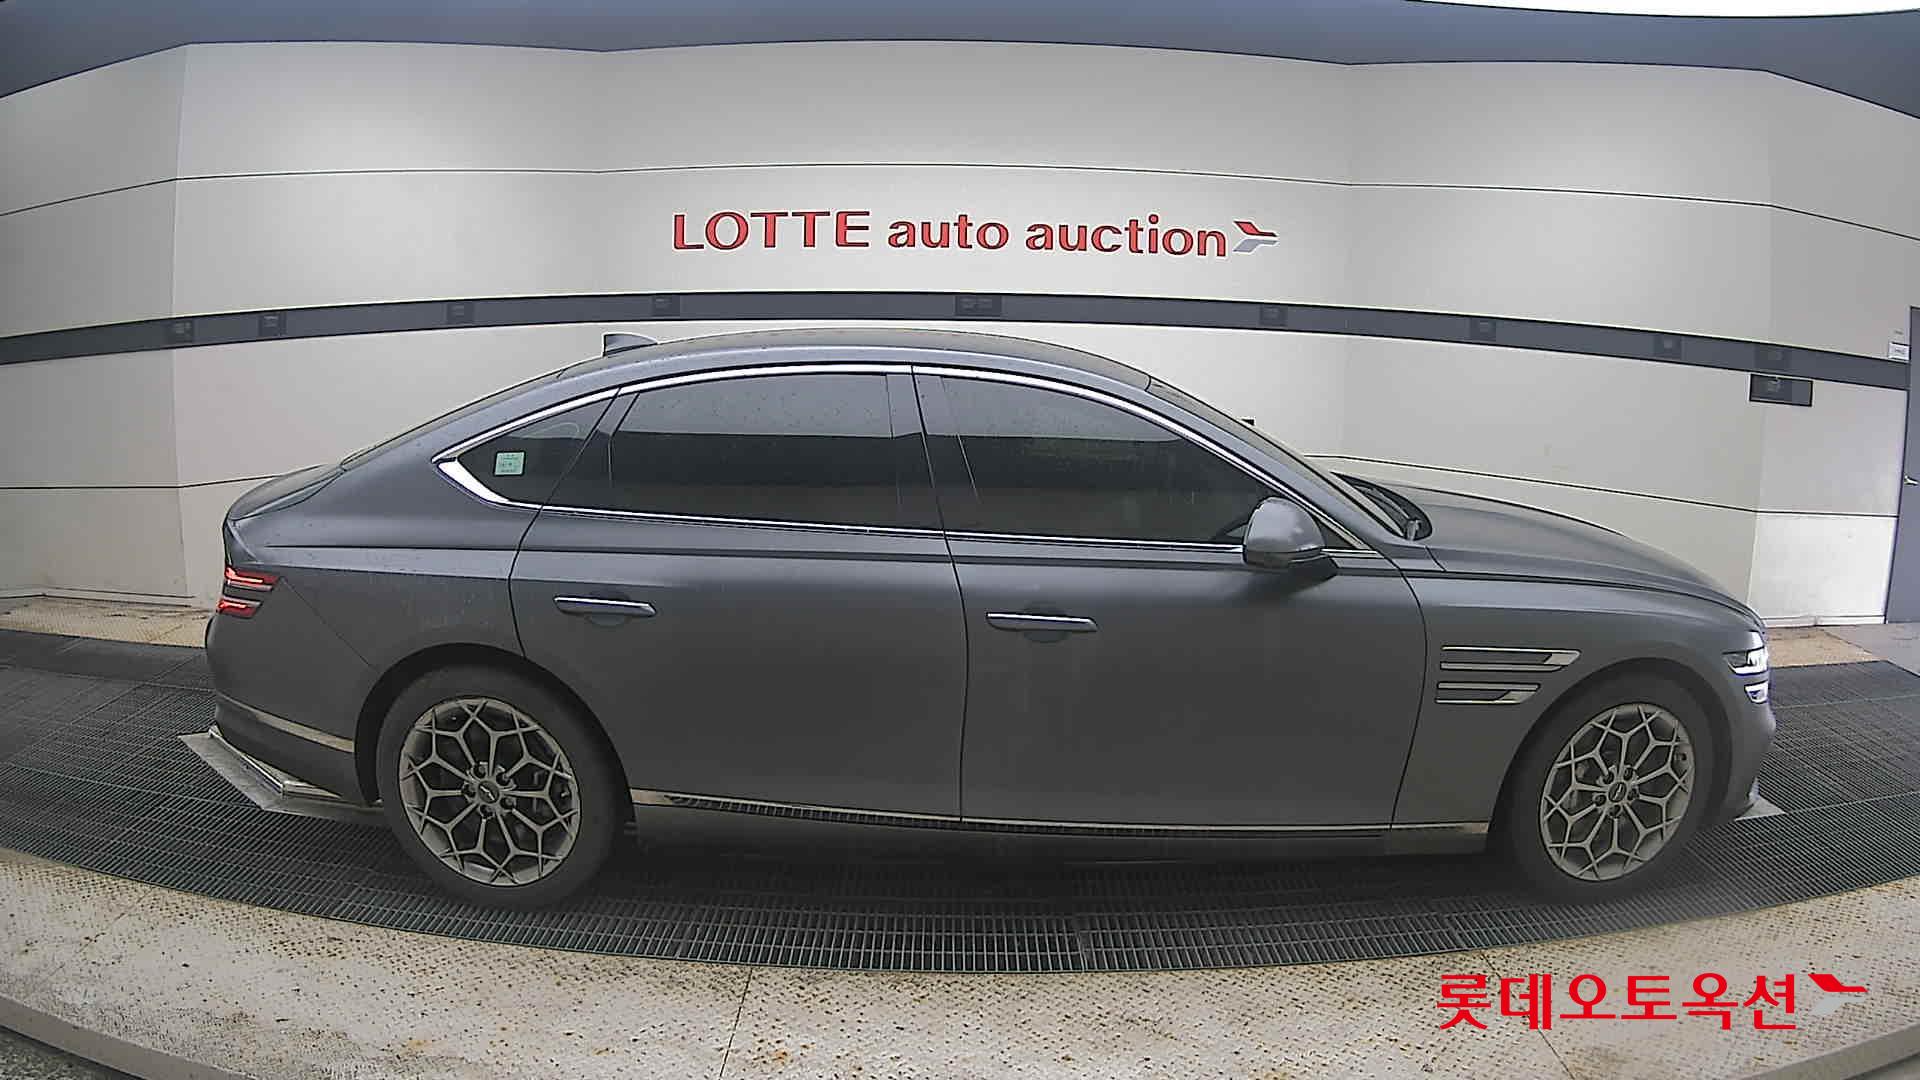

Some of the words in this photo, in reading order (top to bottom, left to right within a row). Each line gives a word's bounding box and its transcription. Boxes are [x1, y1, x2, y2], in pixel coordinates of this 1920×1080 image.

[673, 211, 871, 250] LOTTE
[888, 214, 1010, 249] auto
[1025, 214, 1228, 257] auction
